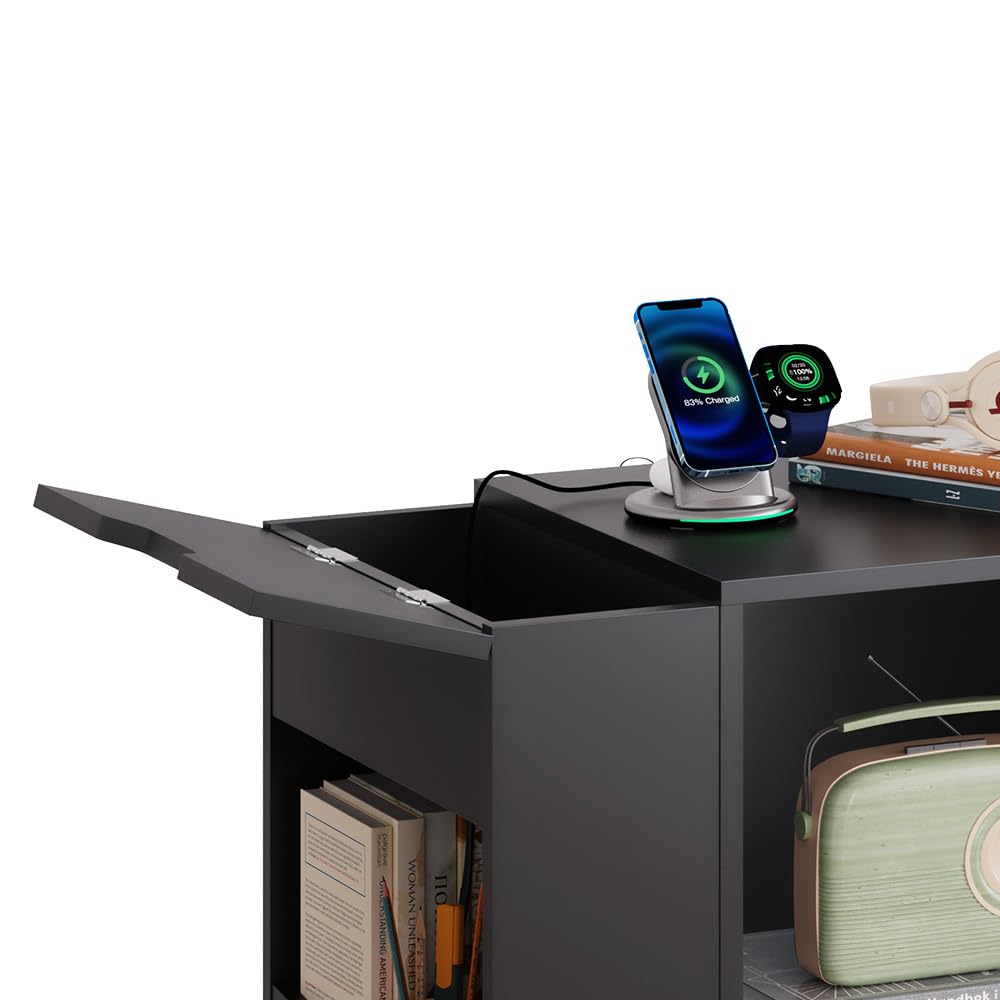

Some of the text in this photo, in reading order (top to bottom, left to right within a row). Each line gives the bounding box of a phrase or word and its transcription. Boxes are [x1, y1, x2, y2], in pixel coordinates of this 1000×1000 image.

[683, 394, 740, 407] 83% Charged
[826, 447, 892, 464] MARGIELA
[905, 458, 929, 469] THE
[407, 859, 417, 991] WOMAN UNLEASHED
[994, 989, 998, 999] i
